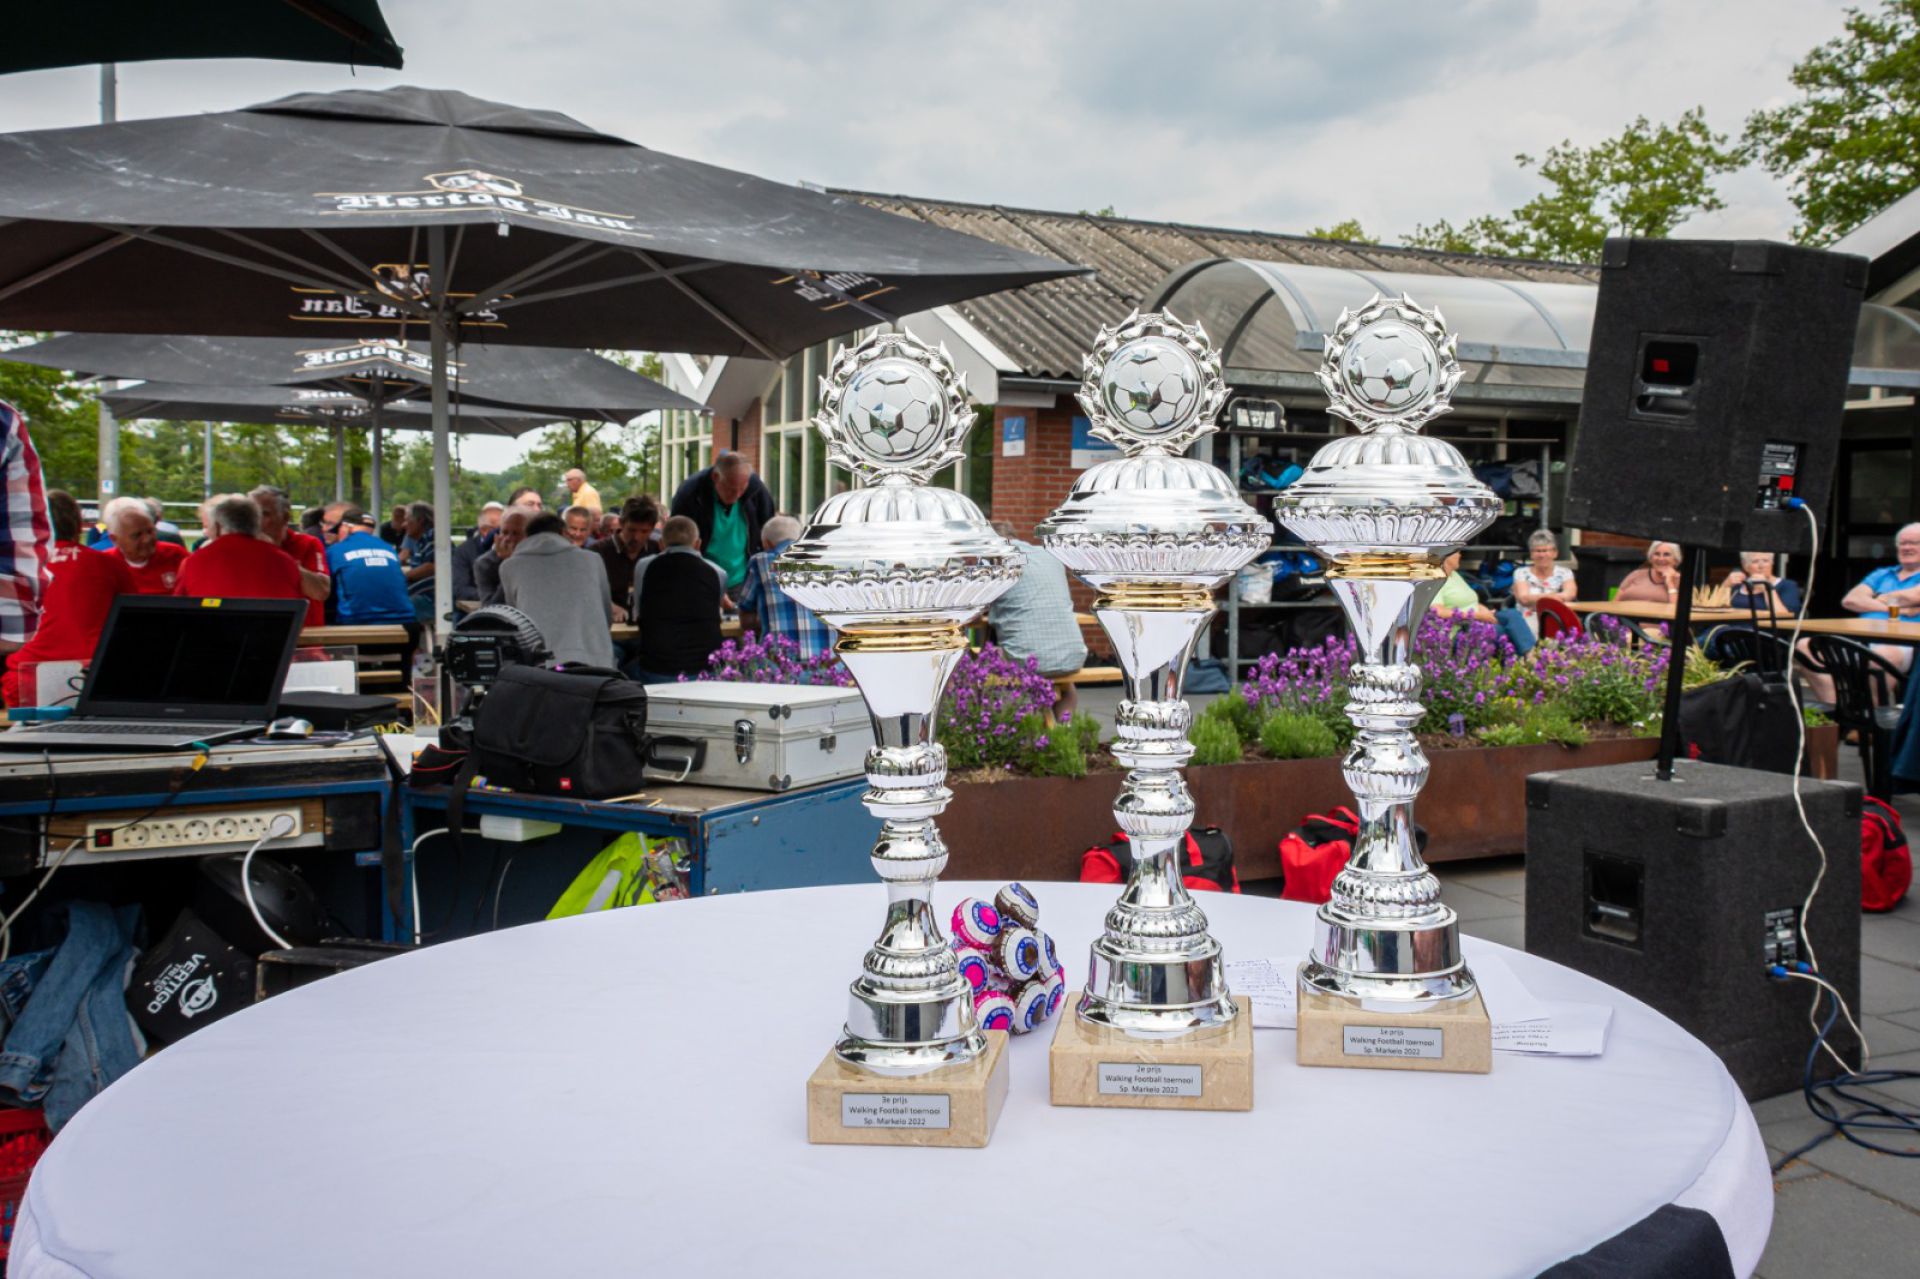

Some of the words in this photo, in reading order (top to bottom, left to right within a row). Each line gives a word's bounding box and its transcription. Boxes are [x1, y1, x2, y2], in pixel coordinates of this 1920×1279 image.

[334, 193, 528, 212] Hertog
[534, 202, 634, 230] Jan
[303, 346, 403, 367] Hertog
[407, 353, 457, 376] Jn
[147, 953, 206, 1013] VERTIGO
[1389, 1028, 1404, 1036] prijs
[1349, 1036, 1376, 1045] Walking
[1377, 1037, 1404, 1045] Football
[1405, 1038, 1435, 1046] toernooi
[1375, 1047, 1402, 1055] Markelo
[1146, 1066, 1161, 1074] prijs
[1105, 1075, 1133, 1083] Walking
[1134, 1075, 1162, 1083] Football
[1163, 1076, 1194, 1084] toernooi
[1132, 1085, 1160, 1093] Markelo
[1161, 1086, 1179, 1094] 2022
[881, 1096, 891, 1104] 3e
[892, 1096, 908, 1105] prijs
[848, 1106, 878, 1115] Walking
[879, 1106, 907, 1114] Football
[909, 1107, 941, 1115] toernooi
[876, 1117, 907, 1125] Markelo
